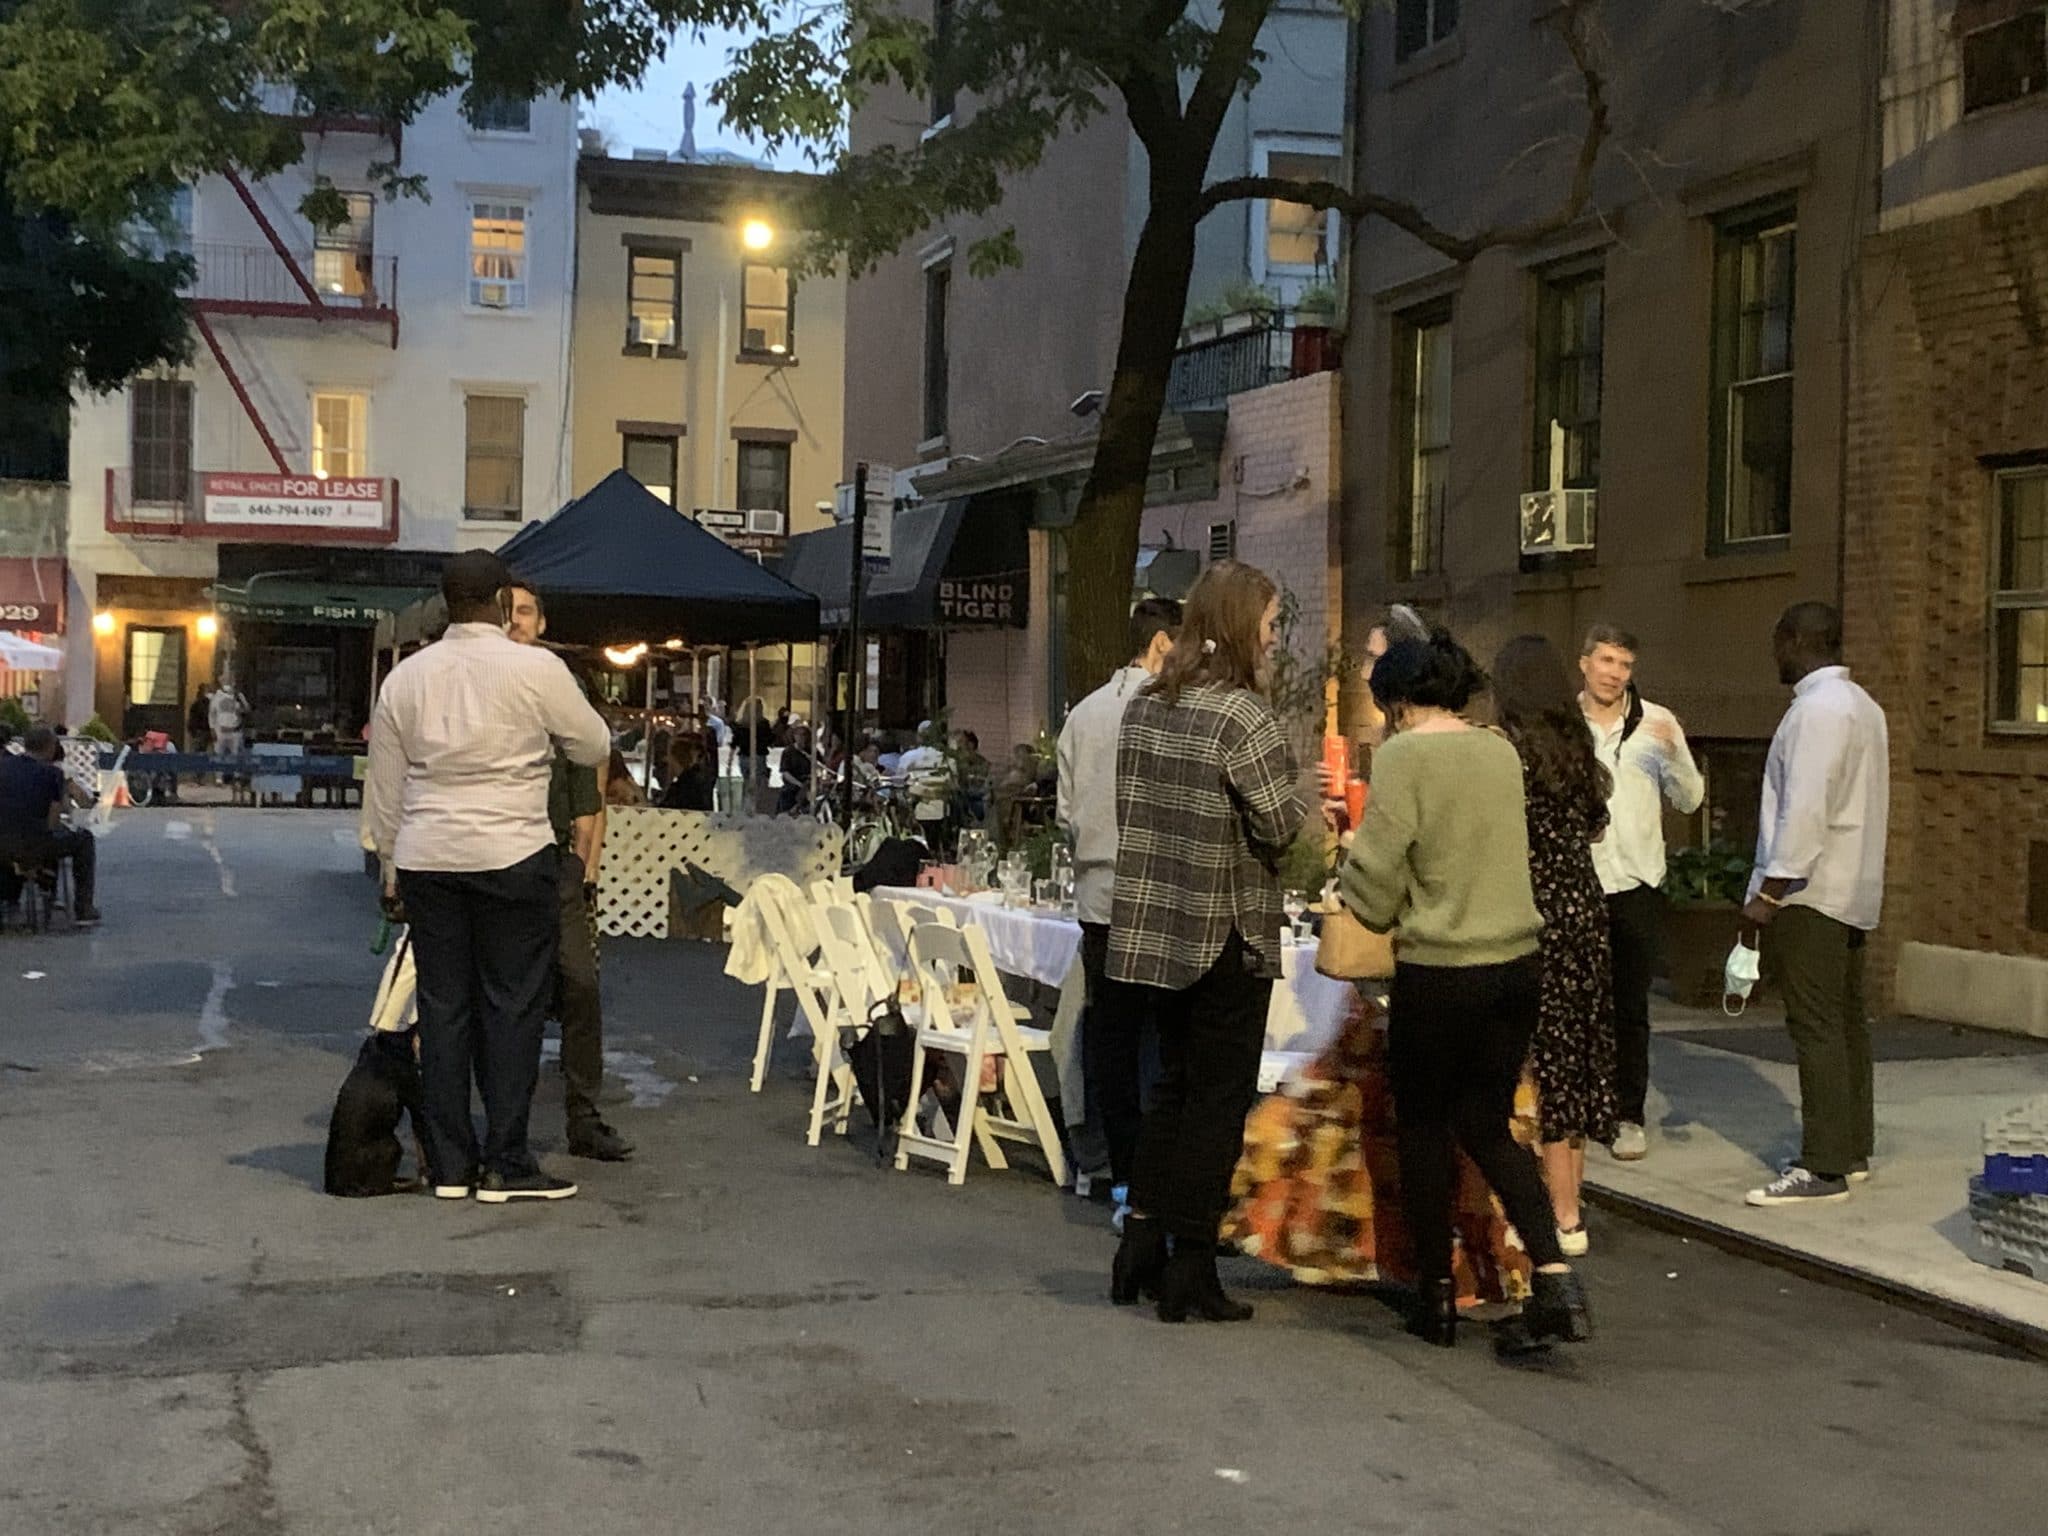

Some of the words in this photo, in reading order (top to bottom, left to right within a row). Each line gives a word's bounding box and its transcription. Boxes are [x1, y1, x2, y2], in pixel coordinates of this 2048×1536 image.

[282, 480, 319, 496] FOR
[324, 482, 378, 498] LEASE
[940, 582, 1014, 600] BLIND
[313, 605, 356, 619] FISH
[940, 600, 1013, 618] TIGER
